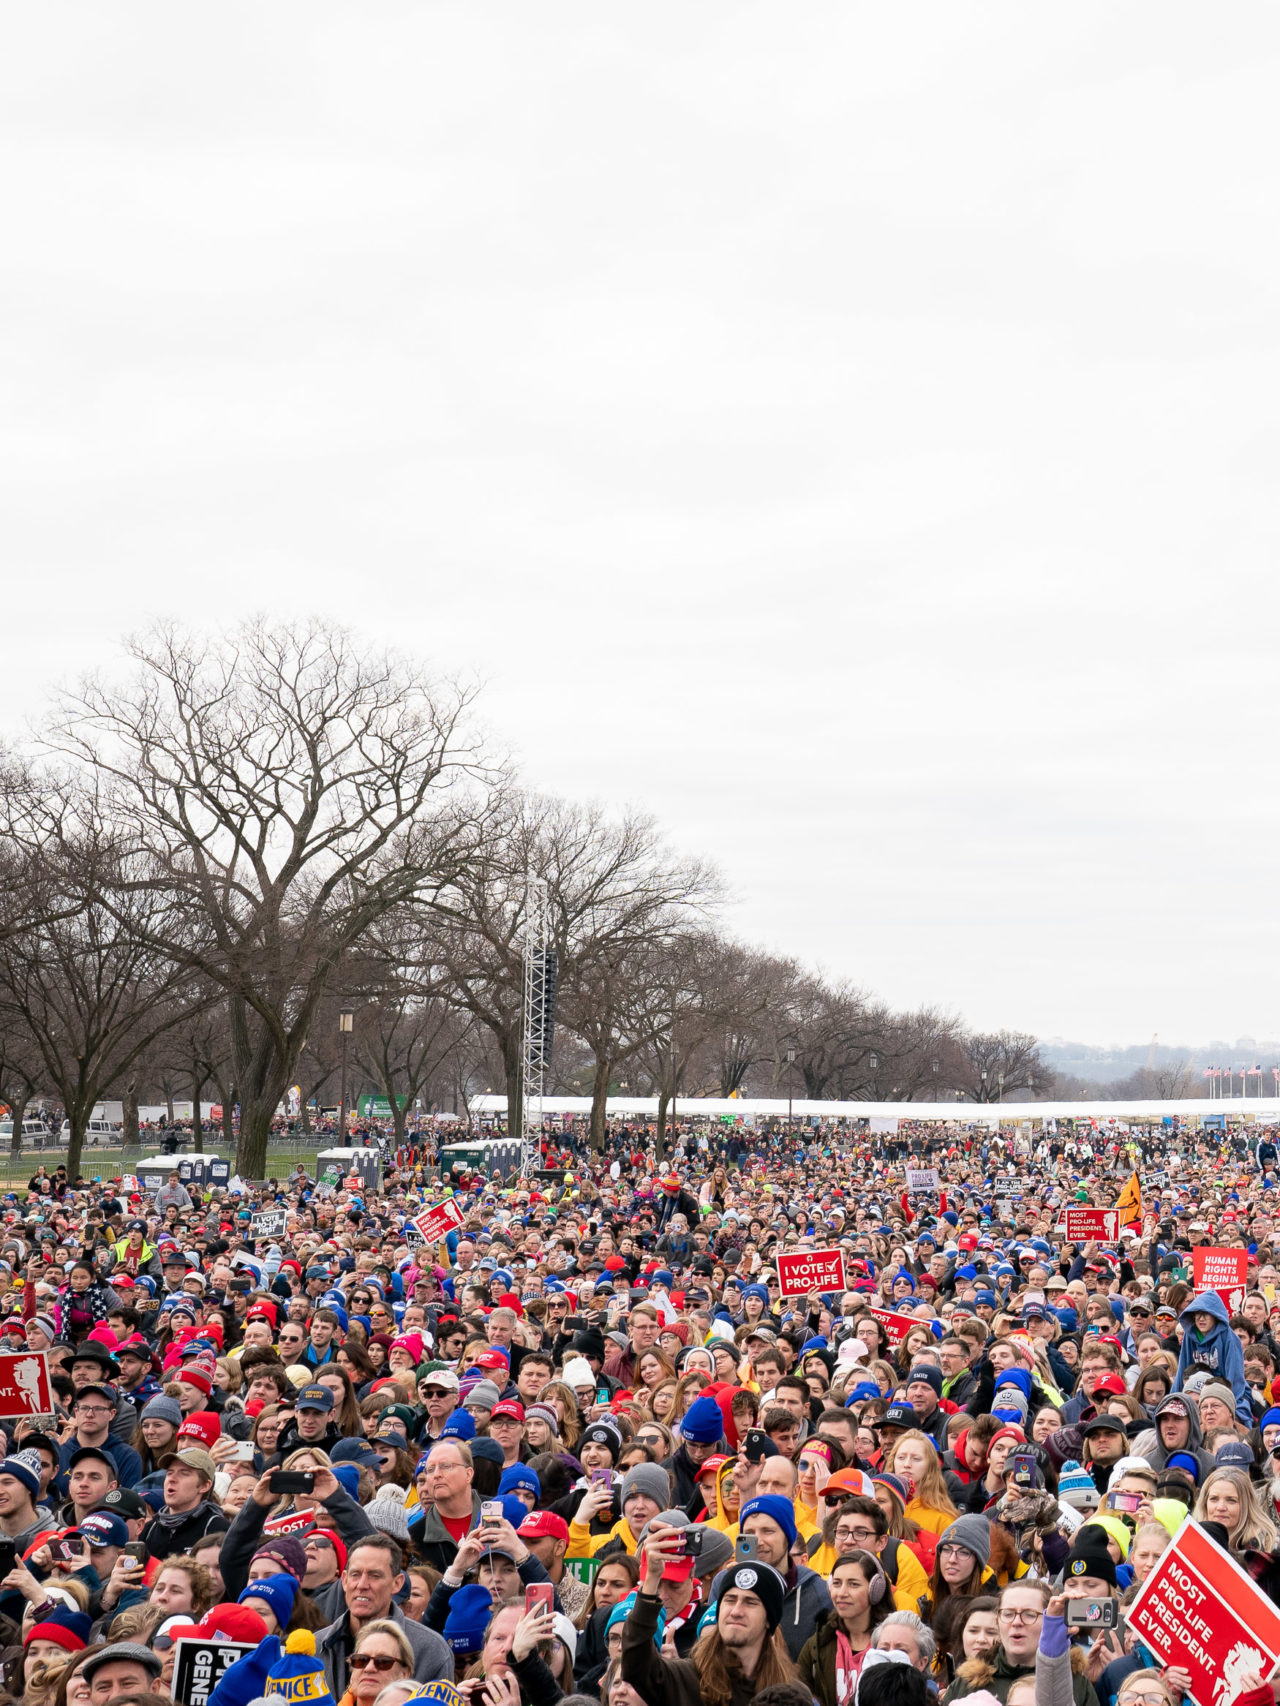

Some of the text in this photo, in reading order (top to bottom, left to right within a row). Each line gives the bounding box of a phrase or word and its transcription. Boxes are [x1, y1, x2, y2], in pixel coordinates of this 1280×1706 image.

[261, 1214, 280, 1222] VOTE
[1205, 1256, 1238, 1264] HUMAN
[785, 1262, 824, 1276] I VOTE
[1205, 1266, 1237, 1275] RIGHTS
[786, 1274, 839, 1290] PRO-LIFE
[1202, 1274, 1239, 1283] BEGIN IN
[871, 1312, 891, 1323] MOST
[81, 1516, 113, 1529] TRUMP
[1167, 1561, 1206, 1603] MOST
[1157, 1577, 1213, 1643] PRO-LIFE
[1138, 1610, 1172, 1655] EVER.
[1147, 1592, 1216, 1676] PRESIDENT.
